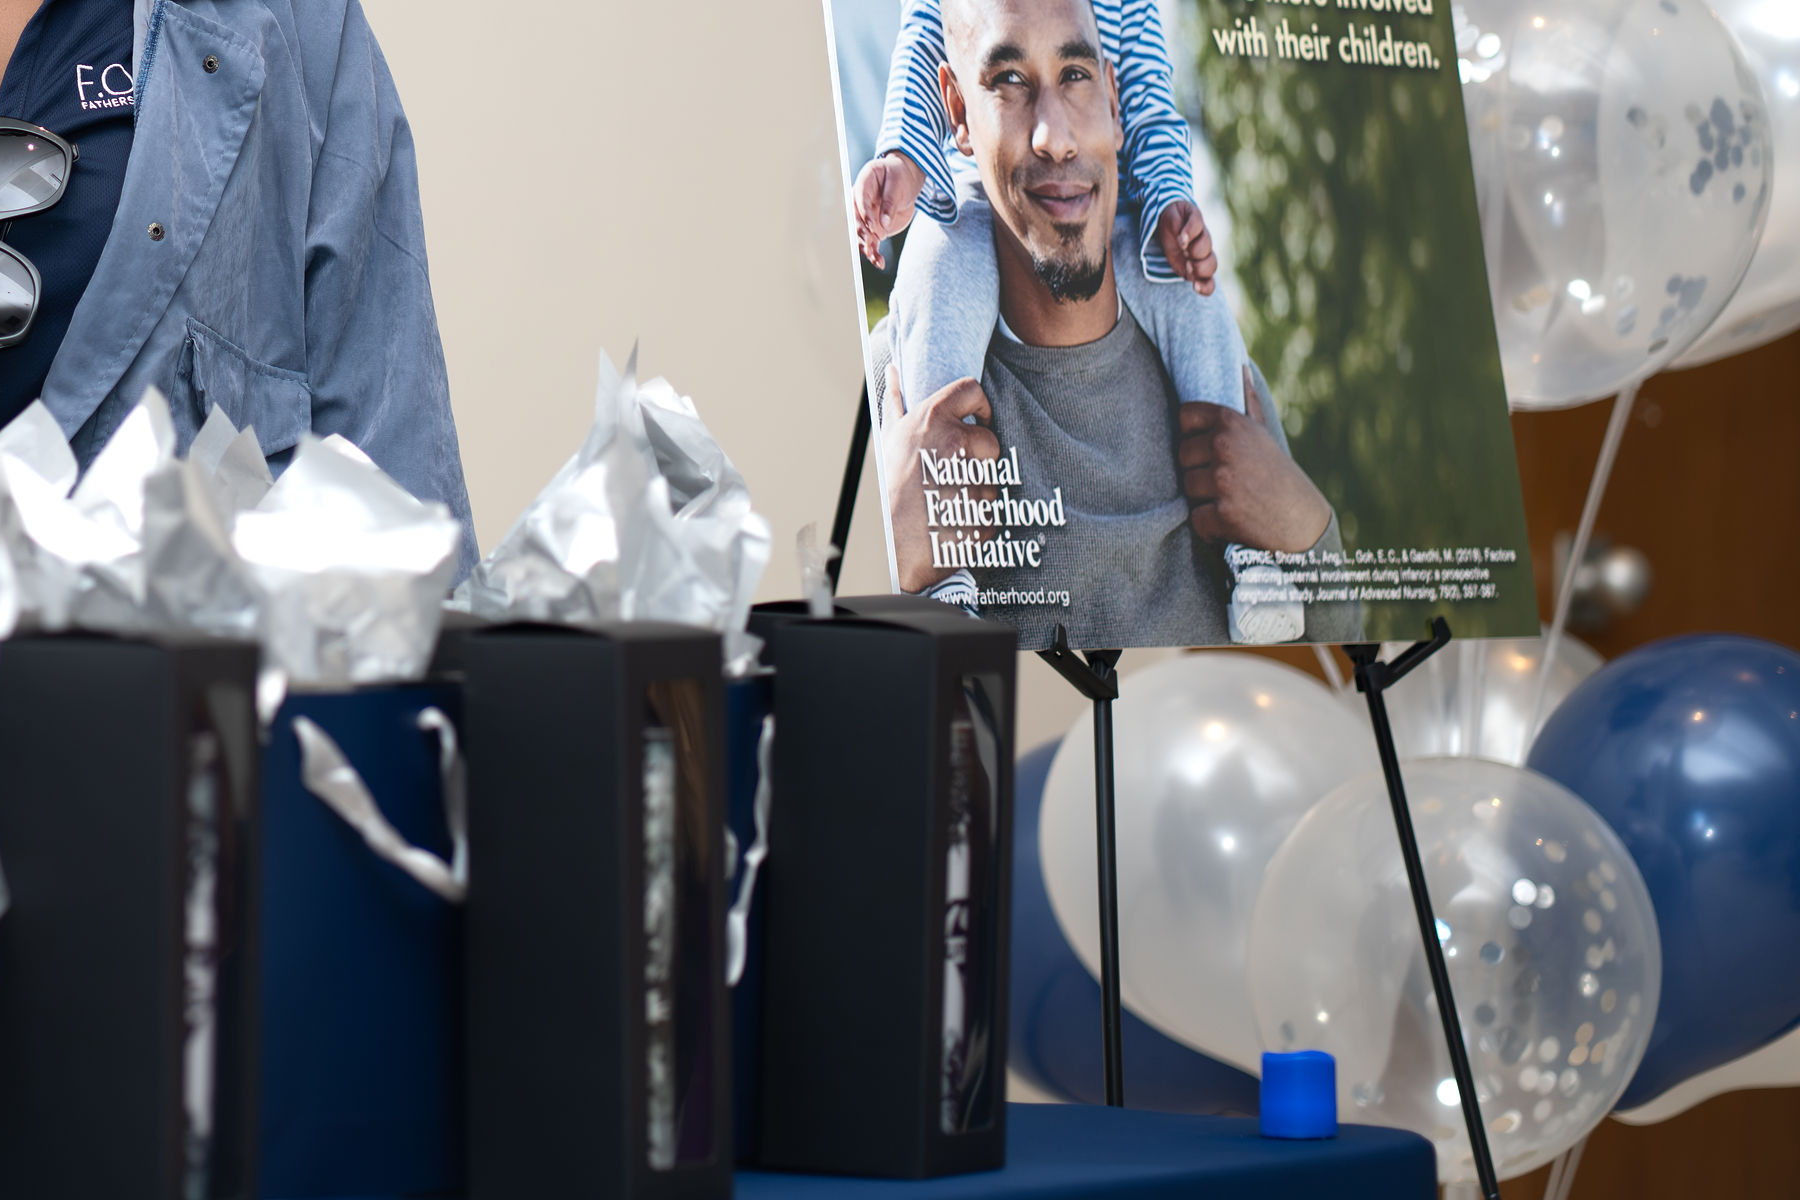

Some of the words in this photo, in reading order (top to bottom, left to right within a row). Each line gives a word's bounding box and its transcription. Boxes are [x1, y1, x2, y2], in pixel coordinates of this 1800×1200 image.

[1213, 17, 1268, 59] with
[1275, 19, 1331, 62] their
[1338, 23, 1440, 70] children.
[81, 95, 135, 110] FATHERS
[919, 446, 1022, 486] National
[924, 487, 1066, 527] Fatherhood
